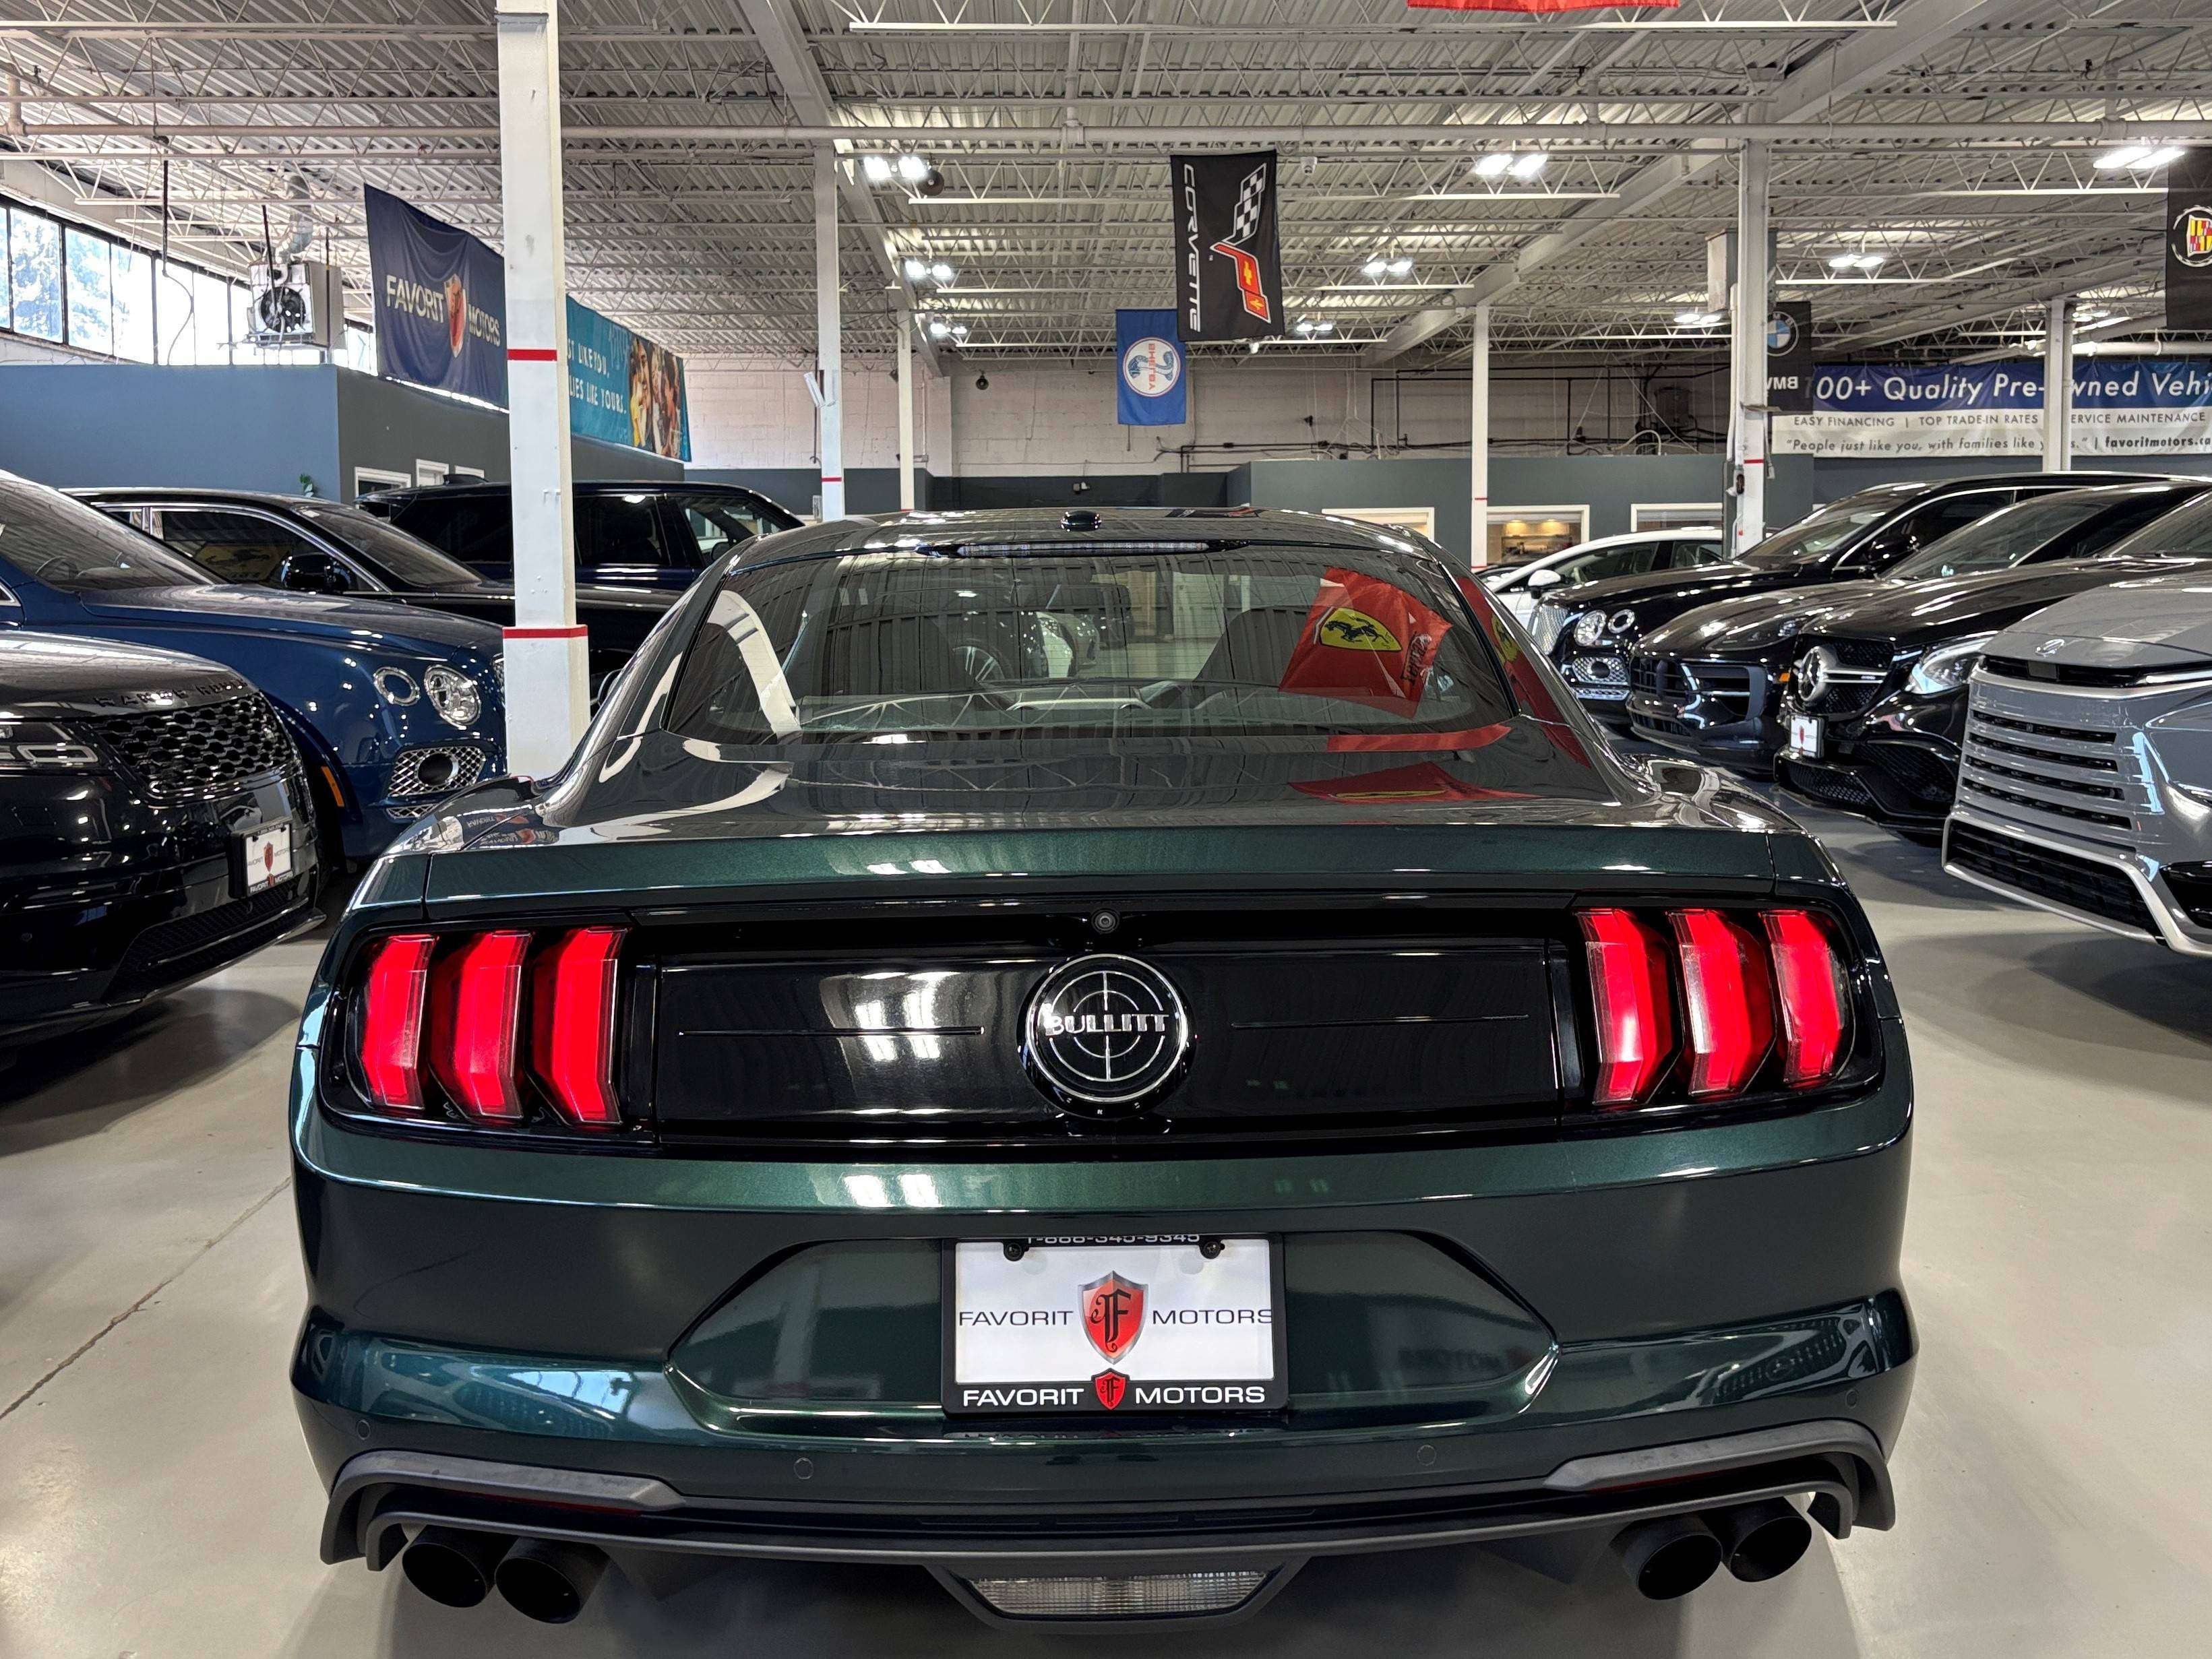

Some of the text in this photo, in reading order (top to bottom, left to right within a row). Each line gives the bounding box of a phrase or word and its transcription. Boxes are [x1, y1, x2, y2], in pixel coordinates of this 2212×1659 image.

[1184, 164, 1200, 332] CORVETTE
[386, 274, 500, 347] FAVORIT MOTORS
[570, 375, 584, 400] LIES
[1884, 373, 1983, 405] Quality
[2152, 370, 2212, 396] Vehi
[1794, 411, 2206, 427] EASY FINANCING TOP TRADE-IN RATES ERVICE MAINTENANCE
[1841, 439, 1864, 453] just
[1869, 438, 1891, 451] like
[1897, 441, 1923, 453] you,
[1928, 439, 1953, 450] with
[1959, 435, 2008, 449] families
[2013, 435, 2035, 448] like
[2105, 435, 2211, 447] favoritmotors.ca
[1045, 1013, 1169, 1036] BULLITT
[959, 1309, 1272, 1327] FAVORIT MOTORS
[963, 1386, 1265, 1407] FAVORIT MOTORS
